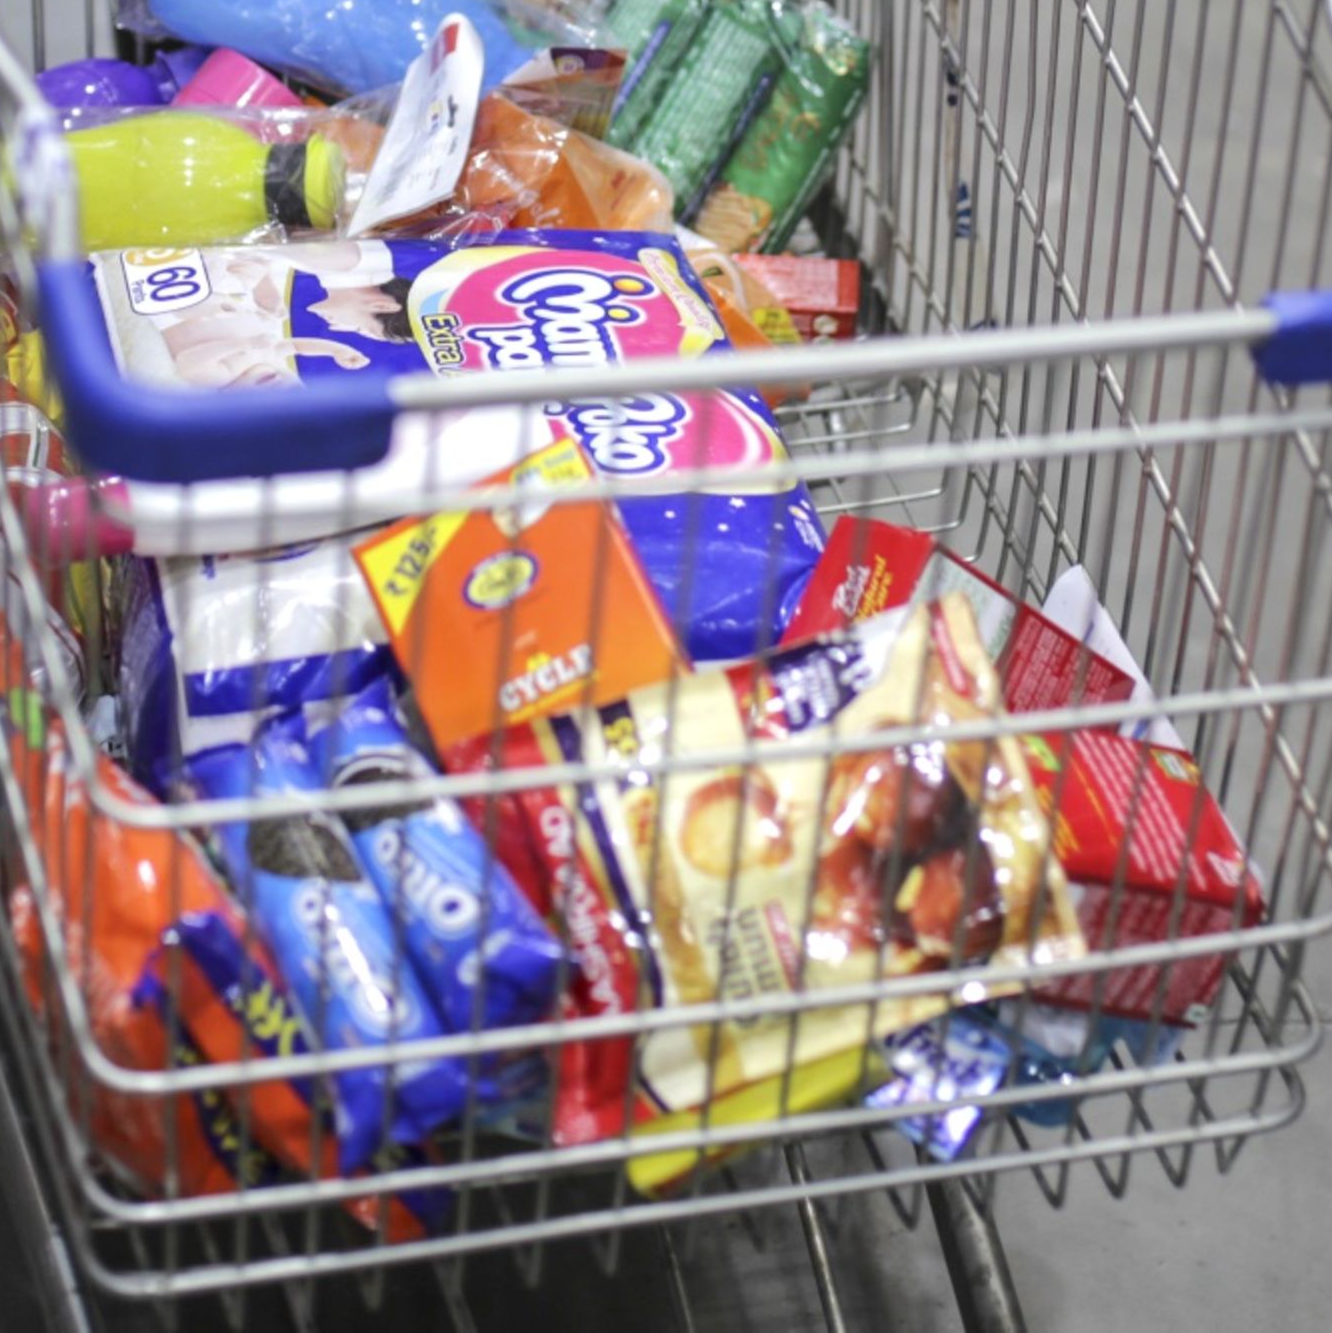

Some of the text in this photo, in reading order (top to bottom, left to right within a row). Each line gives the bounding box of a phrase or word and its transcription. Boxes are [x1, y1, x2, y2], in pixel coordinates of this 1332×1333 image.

[146, 266, 200, 301] 60
[420, 313, 464, 366] Extra
[499, 643, 591, 711] CYCLE
